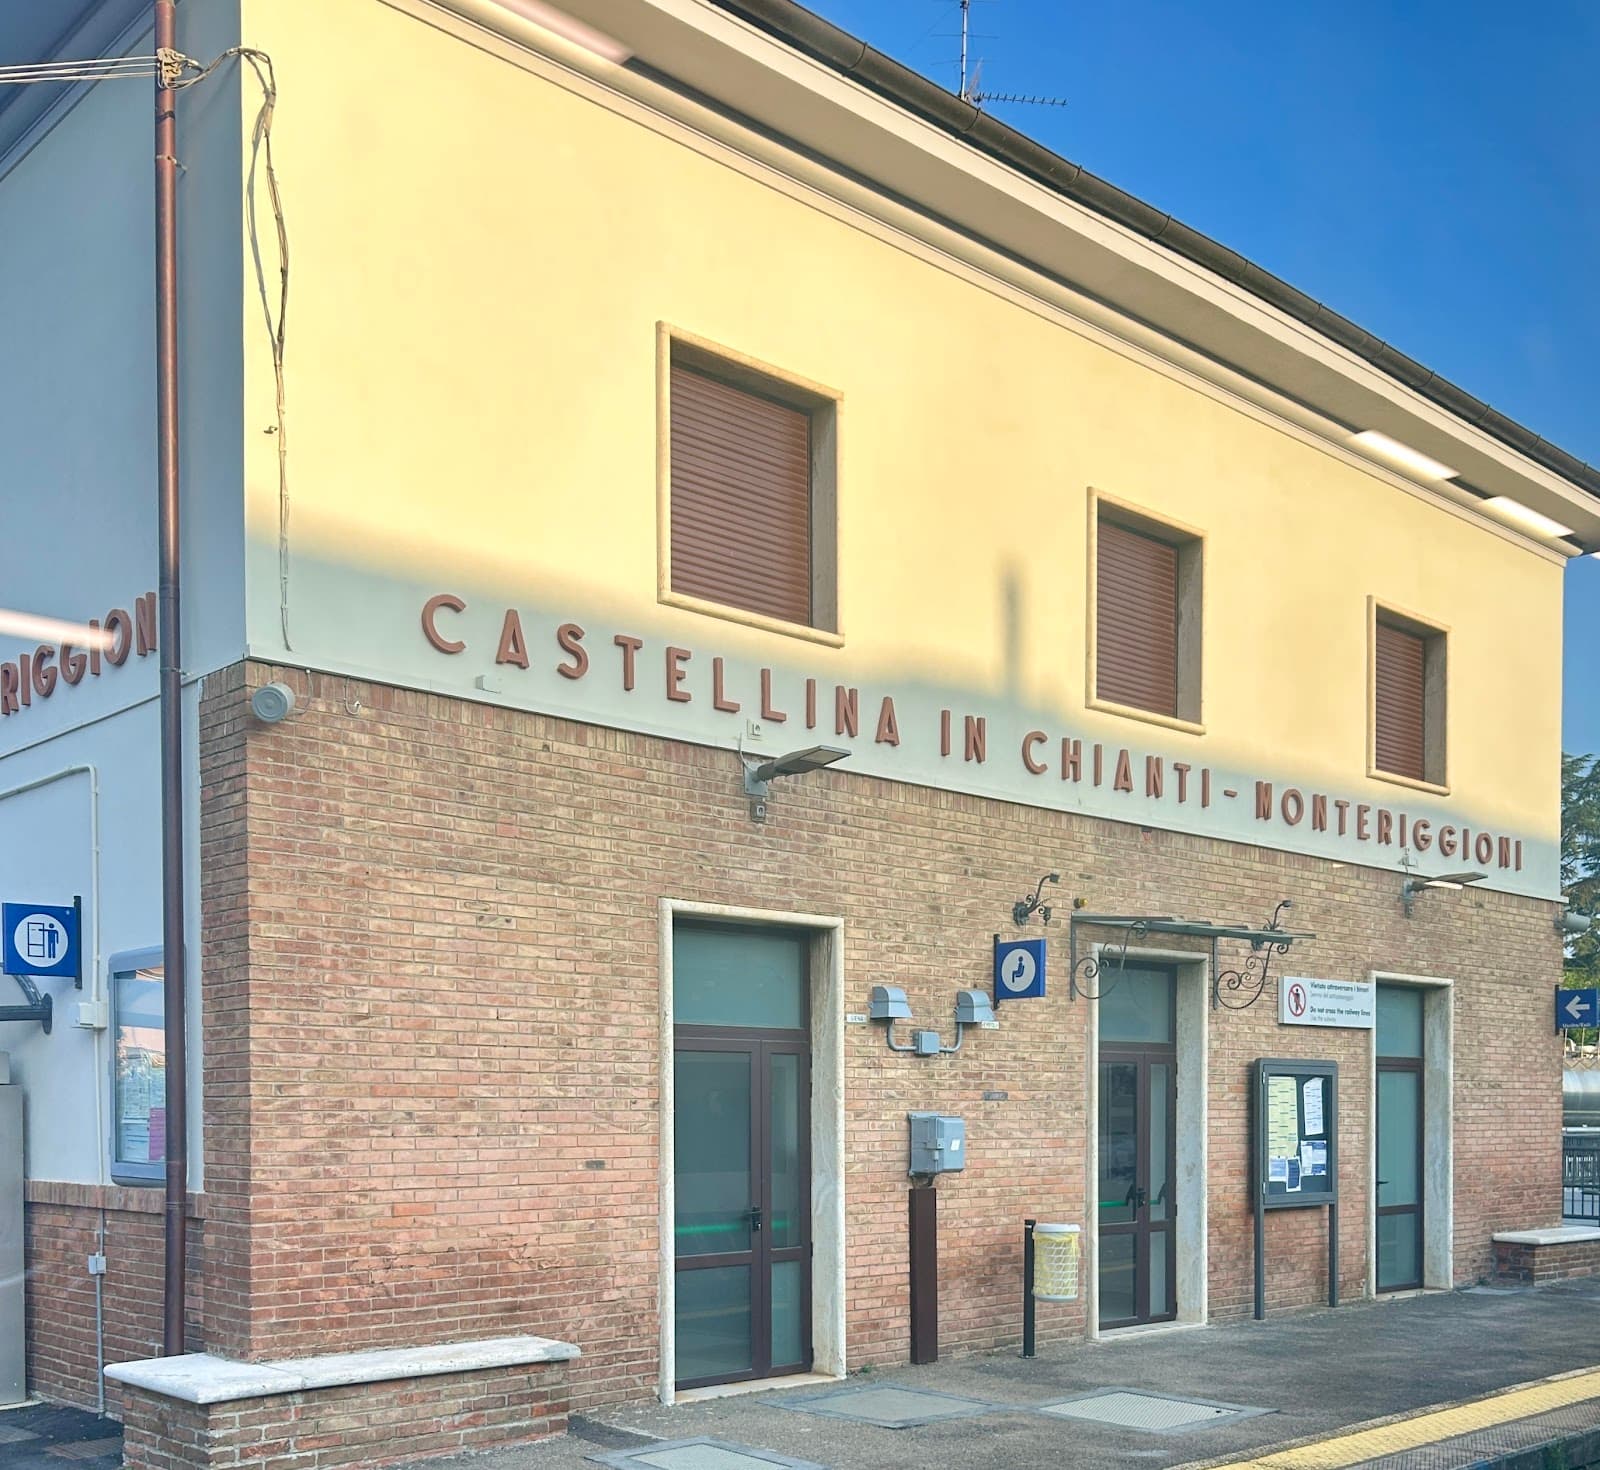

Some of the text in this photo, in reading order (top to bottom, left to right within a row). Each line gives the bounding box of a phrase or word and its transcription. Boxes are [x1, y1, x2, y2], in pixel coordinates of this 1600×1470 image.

[421, 594, 900, 746] CASTELLINA
[940, 709, 986, 763] IN
[1021, 730, 1210, 808] CHIANTI
[1255, 780, 1522, 871] MONTERIGGIONI
